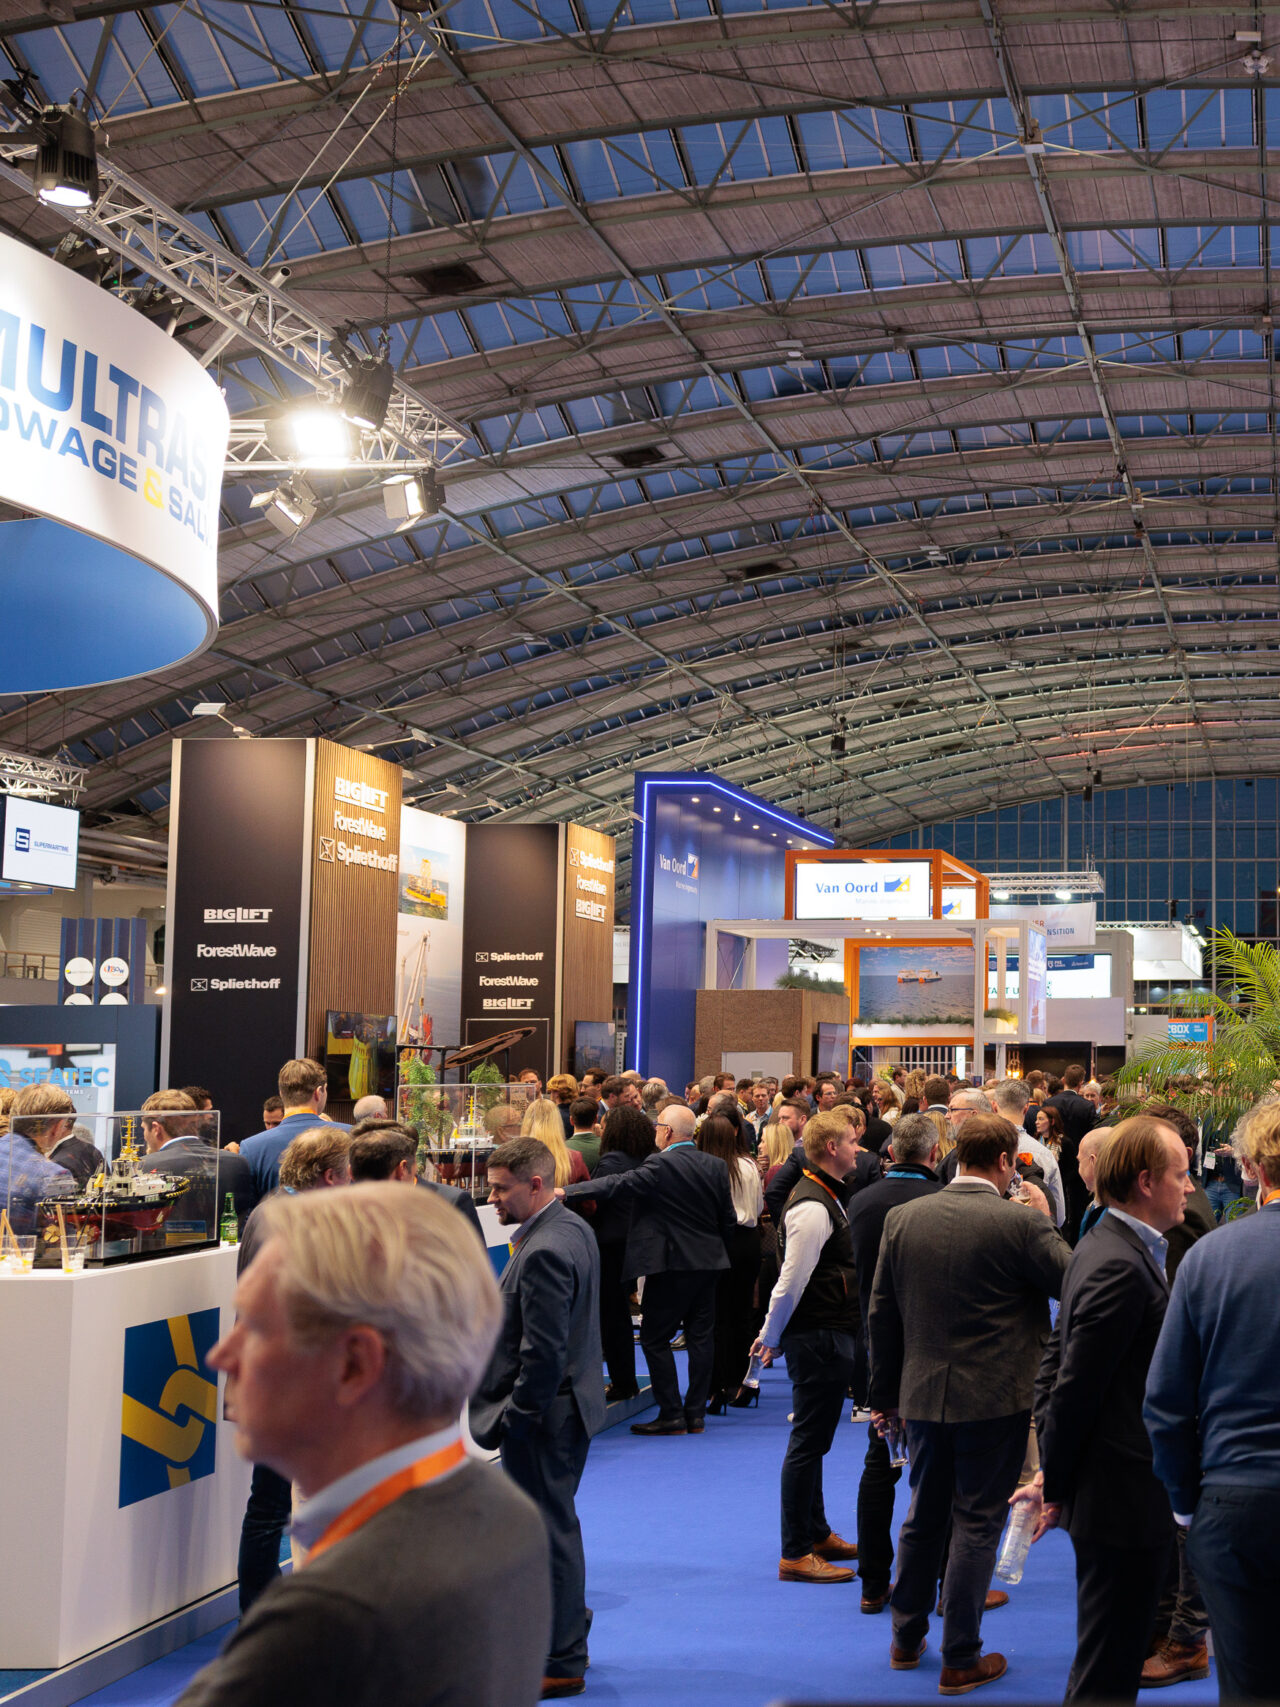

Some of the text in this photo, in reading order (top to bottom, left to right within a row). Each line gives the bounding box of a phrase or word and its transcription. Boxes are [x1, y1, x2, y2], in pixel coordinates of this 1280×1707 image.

[144, 467, 164, 509] &
[168, 485, 208, 545] SAL
[335, 776, 389, 814] BIGLIFT
[337, 841, 398, 873] Spliethoff
[659, 854, 686, 875] Van Oord
[816, 882, 878, 893] Van Oord
[204, 907, 273, 923] BIGLIFT
[1047, 928, 1075, 936] NSITION
[197, 944, 277, 958] ForestWave
[490, 952, 544, 962] Spliethoff
[210, 978, 280, 991] Spliethoff
[479, 976, 539, 986] ForestWave
[483, 997, 534, 1010] BIGLIFT
